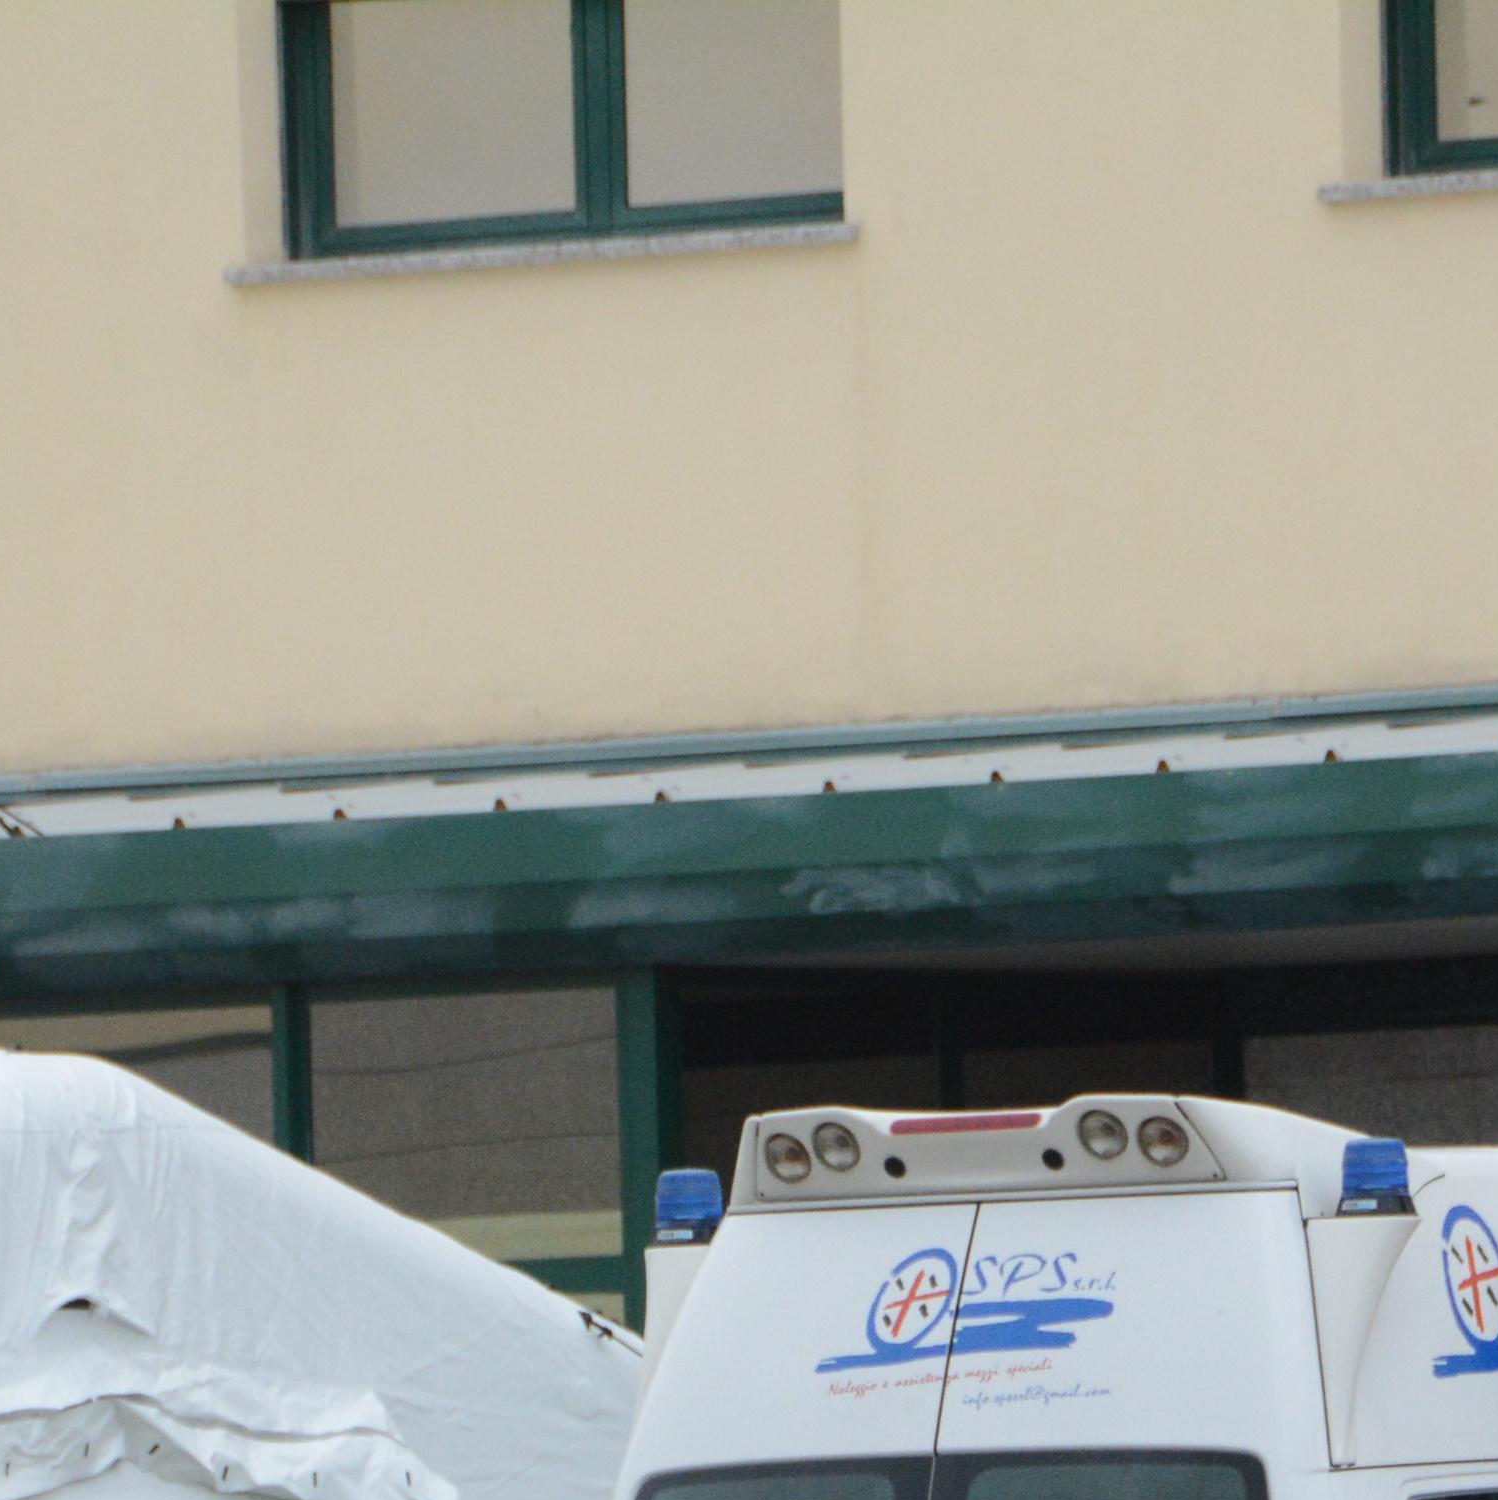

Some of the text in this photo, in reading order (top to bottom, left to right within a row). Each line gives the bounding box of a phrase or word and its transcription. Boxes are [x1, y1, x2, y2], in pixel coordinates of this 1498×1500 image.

[961, 1252, 1077, 1297] SPS
[828, 1380, 877, 1398] Noleggio
[964, 1365, 998, 1382] mezzi
[1006, 1357, 1054, 1376] speciali
